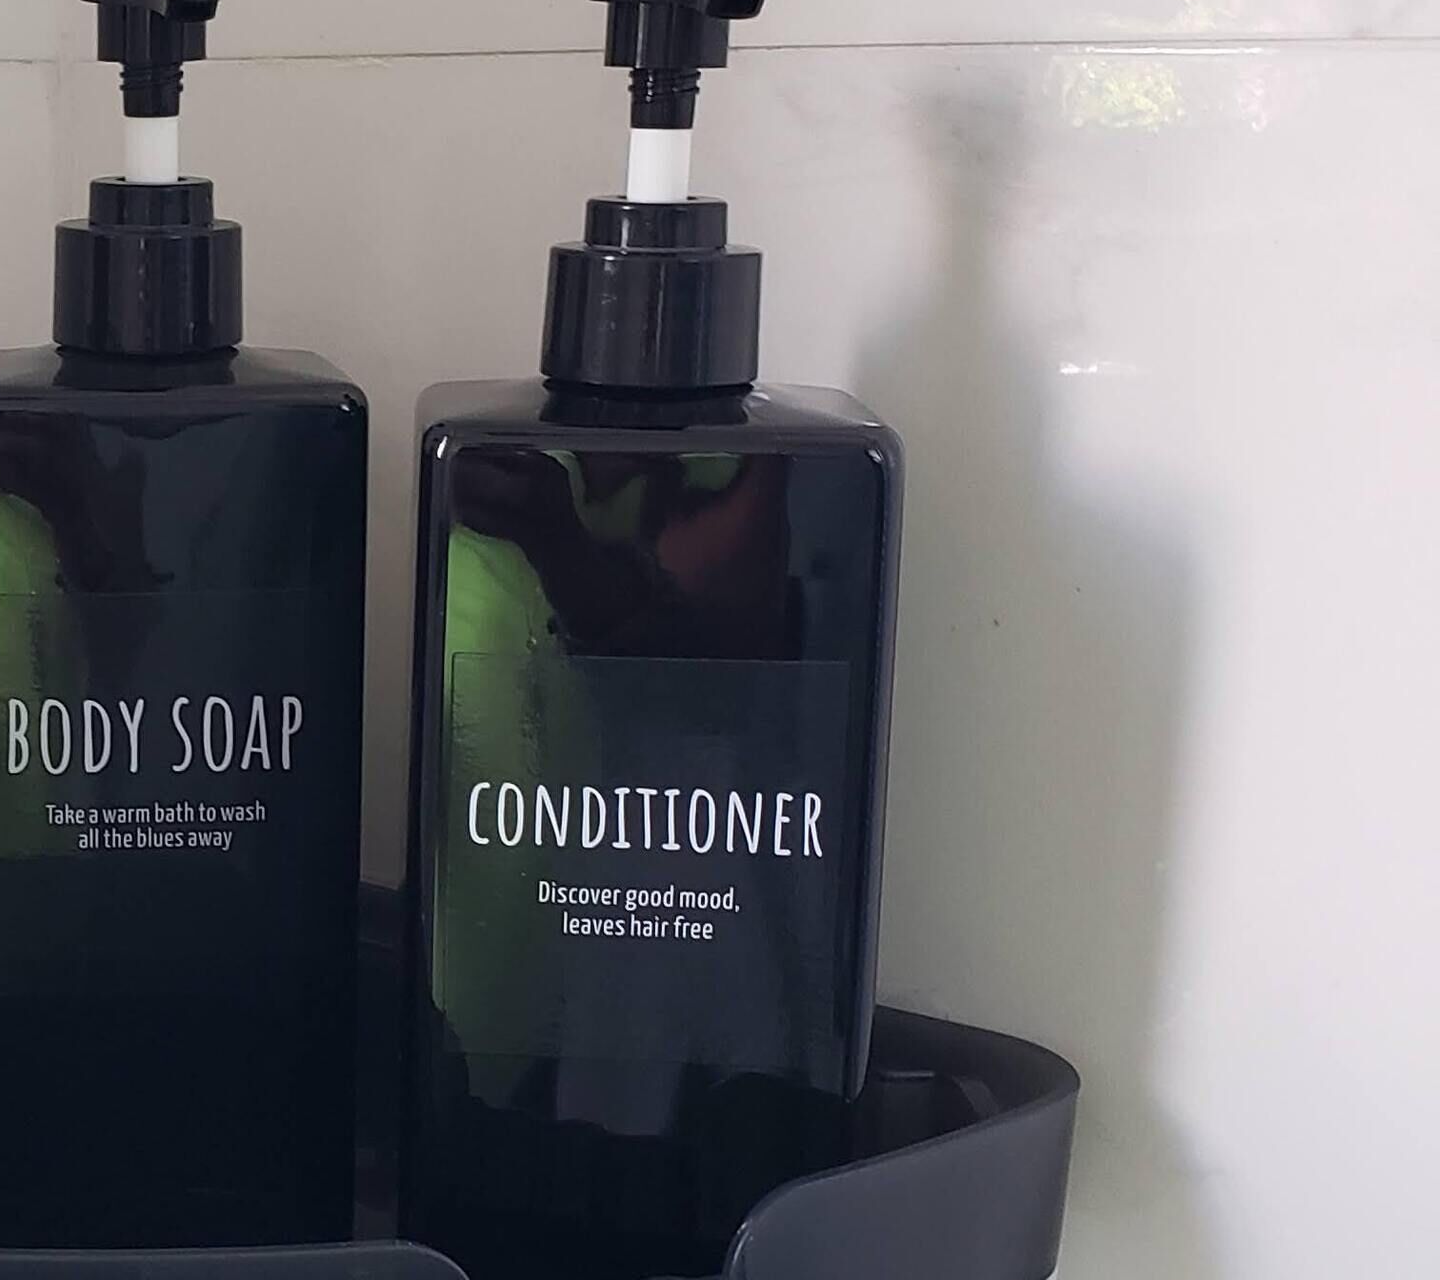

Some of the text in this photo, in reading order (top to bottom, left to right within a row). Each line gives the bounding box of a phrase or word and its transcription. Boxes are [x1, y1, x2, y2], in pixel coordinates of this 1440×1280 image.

[7, 695, 303, 775] BODY SOAP
[46, 800, 266, 825] Take a warm bath to wash
[467, 781, 824, 858] CONDITIONER
[78, 827, 233, 851] all the blues away
[538, 880, 741, 913] Discover good mood,
[562, 912, 714, 940] leaves hair free
